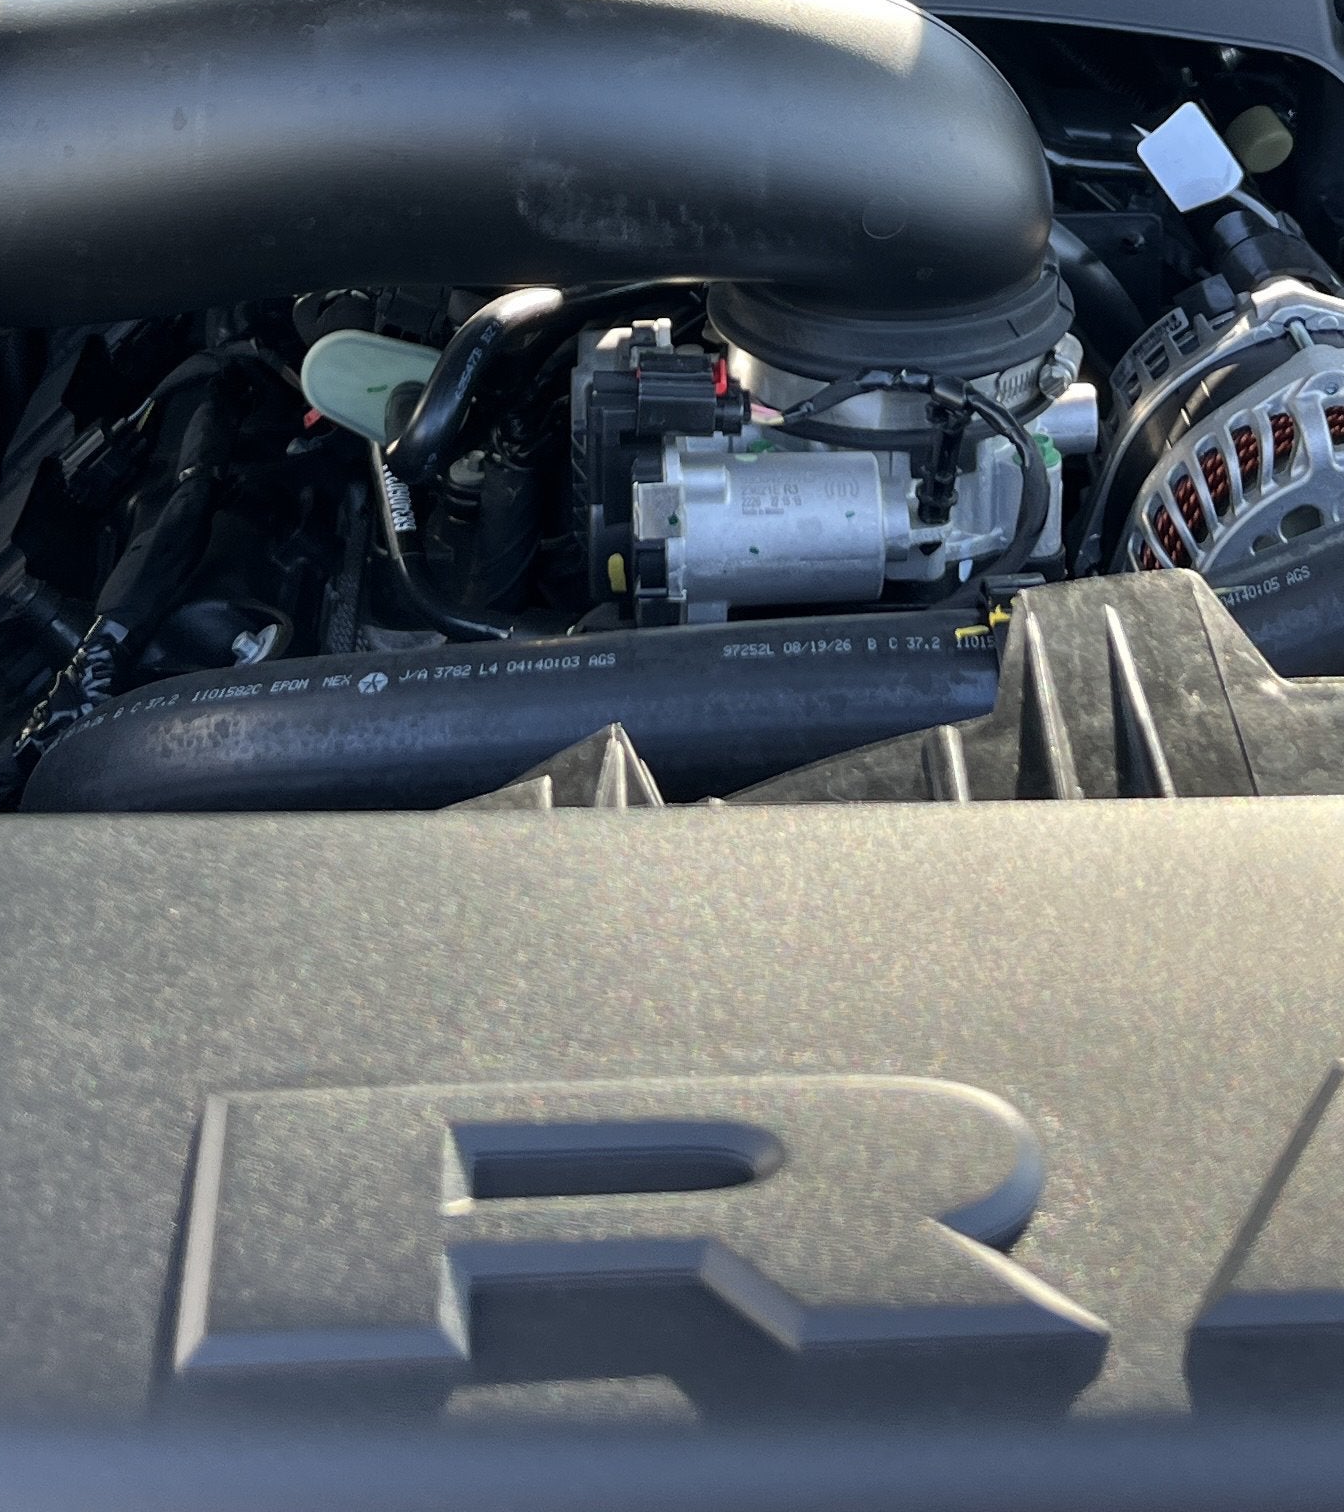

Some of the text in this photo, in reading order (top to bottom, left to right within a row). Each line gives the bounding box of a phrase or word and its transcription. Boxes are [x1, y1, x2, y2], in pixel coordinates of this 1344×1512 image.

[1285, 565, 1311, 586] AGS
[782, 638, 853, 655] 08/19/26
[867, 638, 878, 651] B
[889, 637, 898, 650] C
[906, 635, 941, 651] 37.2
[322, 673, 353, 687] MEX
[433, 664, 473, 679] 3782
[479, 661, 499, 676] L4
[588, 652, 617, 666] AGS
